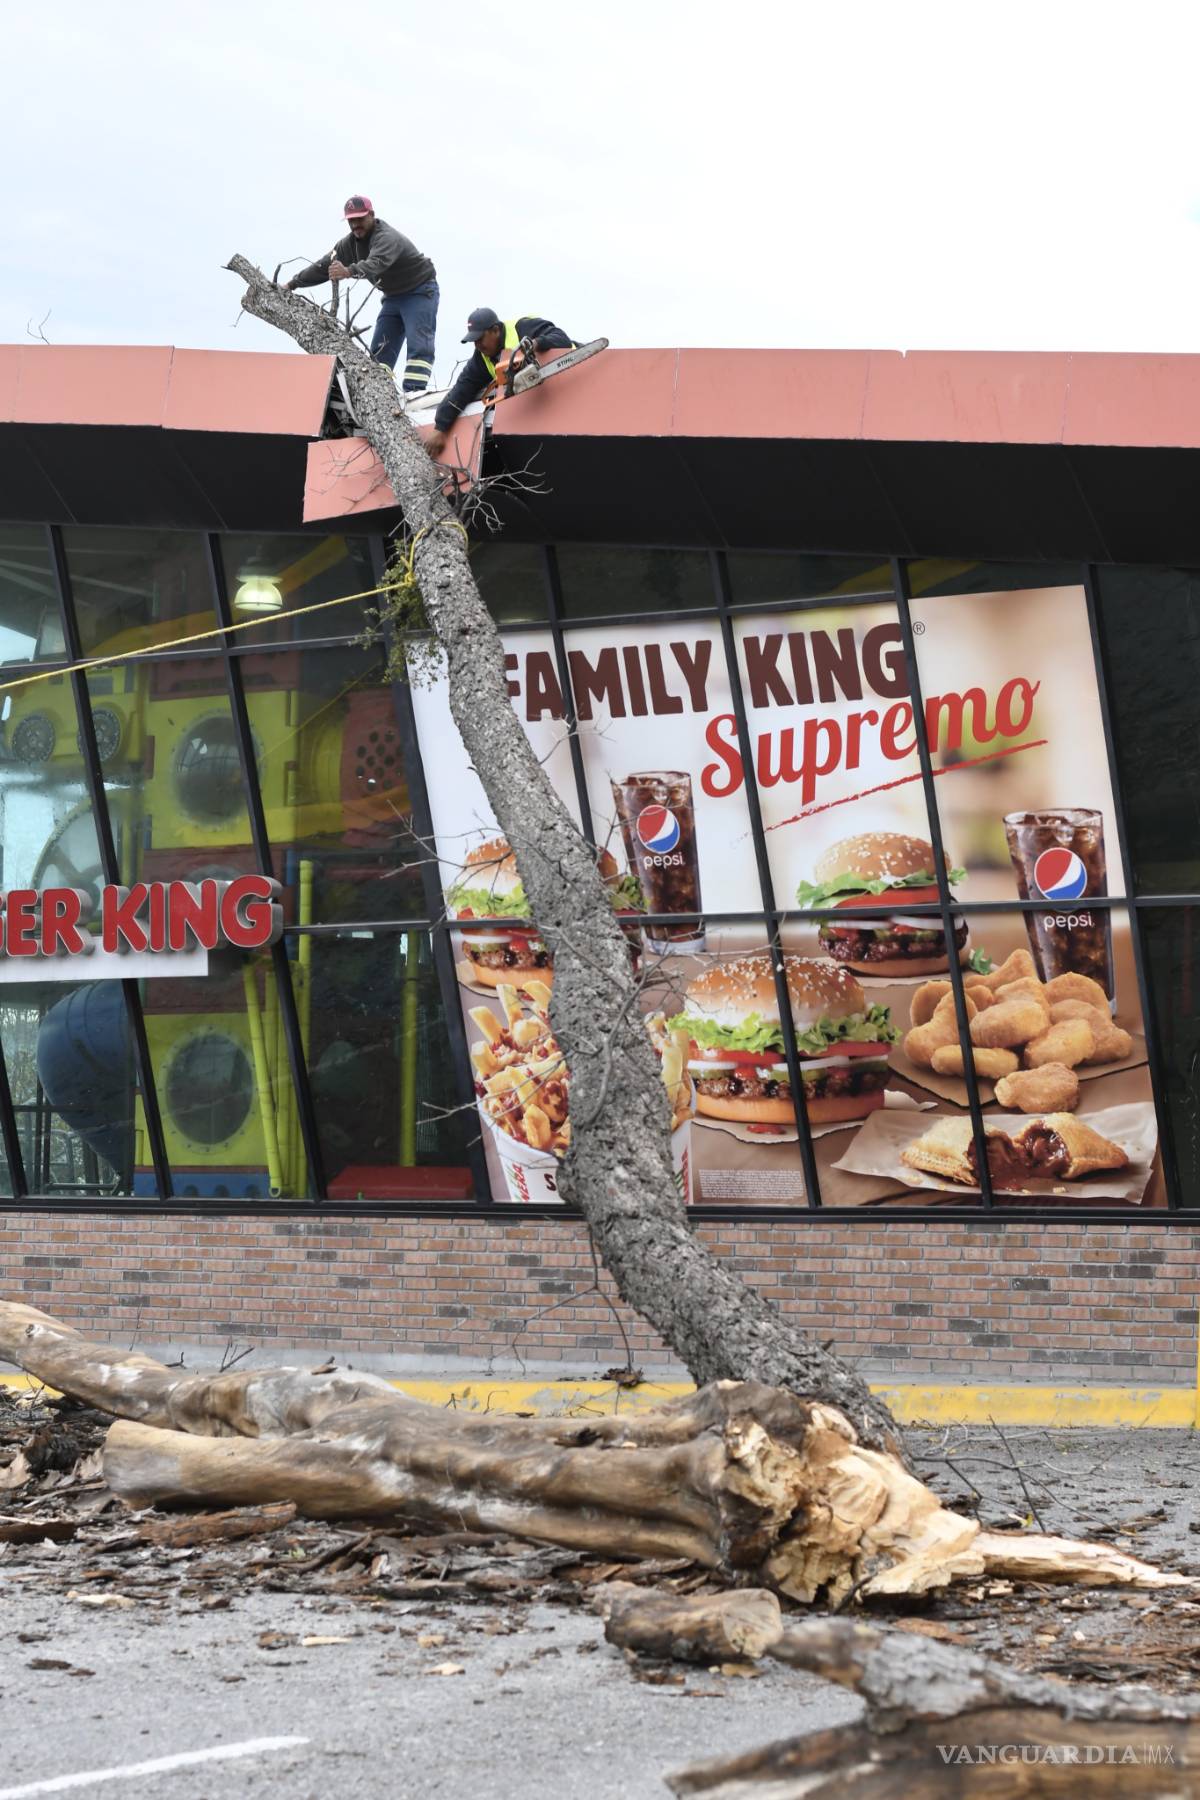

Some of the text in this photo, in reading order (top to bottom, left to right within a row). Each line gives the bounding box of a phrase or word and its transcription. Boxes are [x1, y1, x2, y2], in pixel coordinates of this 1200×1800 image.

[701, 677, 1041, 807] Supremo
[643, 851, 684, 870] pepsi
[0, 874, 274, 956] ER KING
[1043, 911, 1092, 932] pepsi
